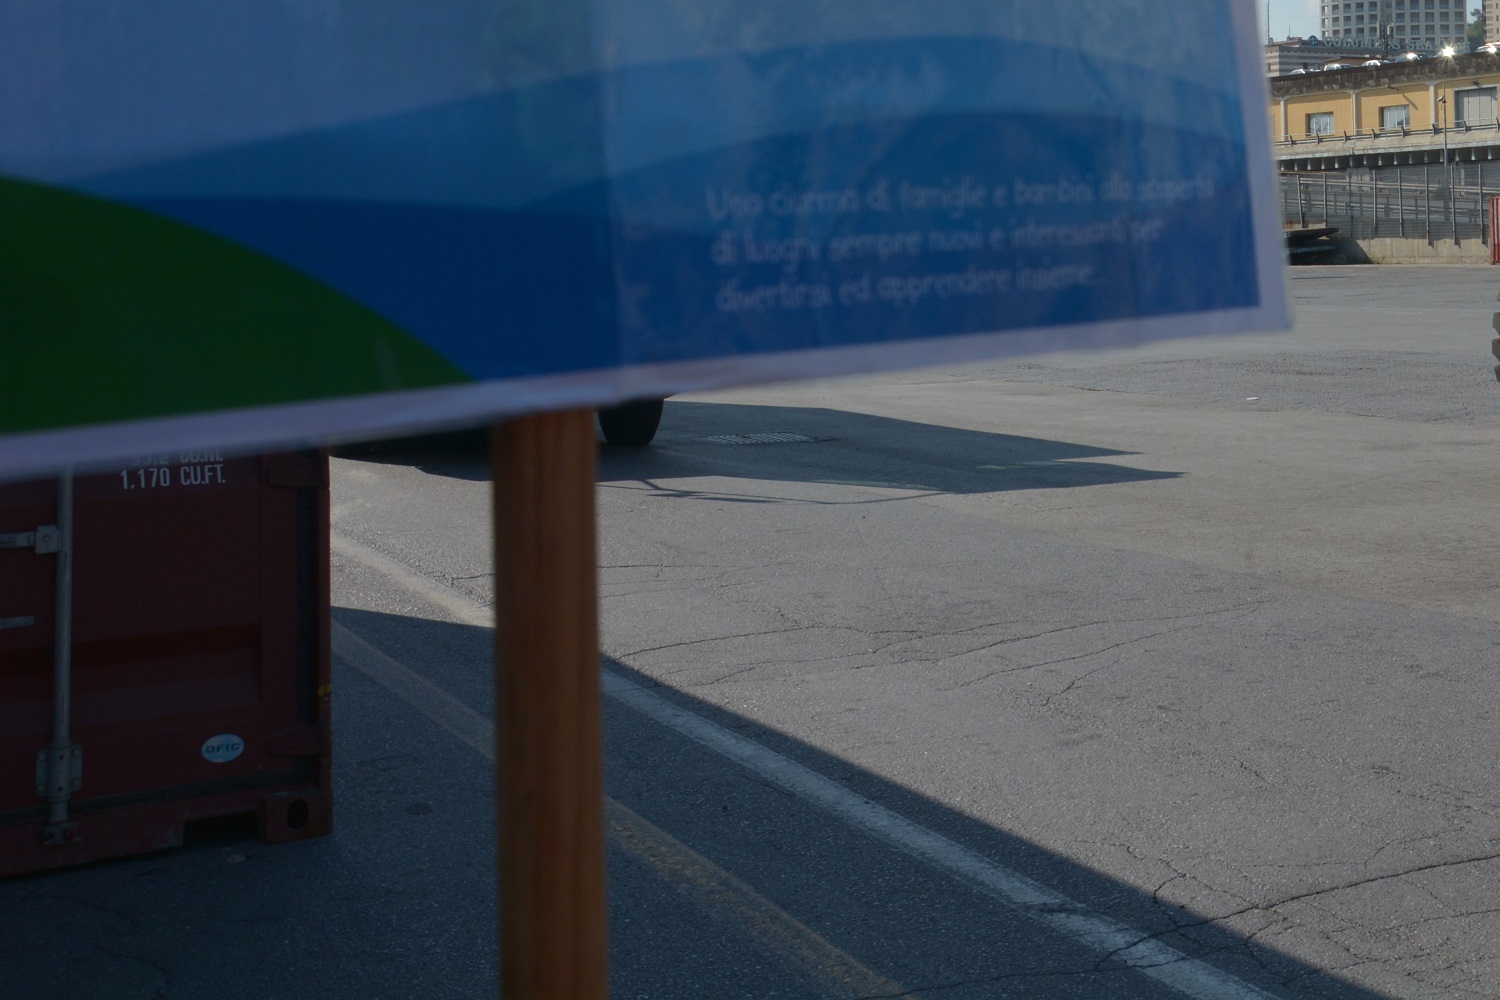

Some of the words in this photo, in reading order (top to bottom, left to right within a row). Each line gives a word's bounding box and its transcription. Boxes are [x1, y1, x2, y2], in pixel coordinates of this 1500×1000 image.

[1322, 36, 1401, 51] COLUMBS
[866, 179, 890, 212] di
[899, 176, 987, 219] famiglie
[992, 183, 1008, 208] e
[1014, 173, 1095, 206] bambini
[710, 230, 738, 266] di
[744, 229, 820, 274] luoghi
[828, 232, 922, 264] sempre
[928, 220, 984, 252] nuovi
[989, 226, 1006, 250] e
[1131, 218, 1165, 248] per
[715, 272, 832, 313] divertirsi
[838, 270, 872, 306] ed
[877, 264, 1011, 308] apprendere
[205, 742, 240, 753] DFIC
